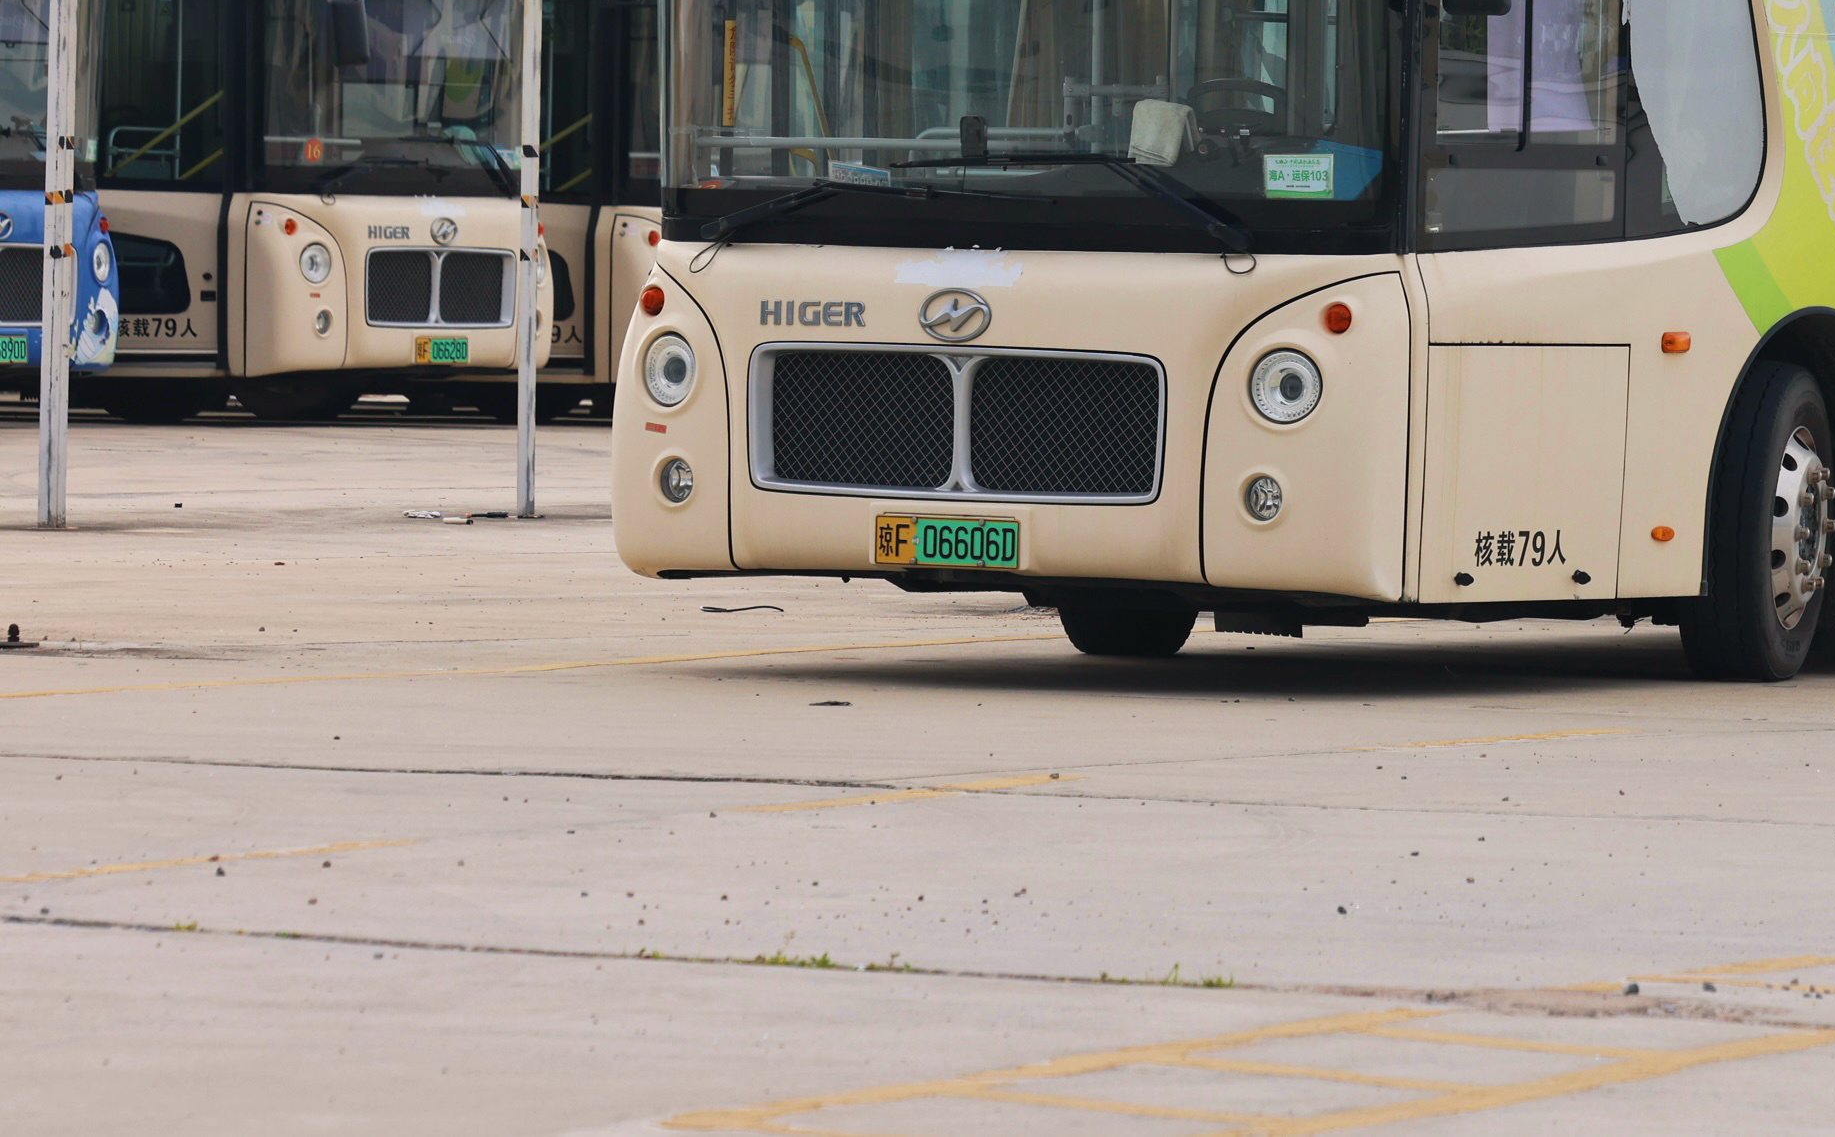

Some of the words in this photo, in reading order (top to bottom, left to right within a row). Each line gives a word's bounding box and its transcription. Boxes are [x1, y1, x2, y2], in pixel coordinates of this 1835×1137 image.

[306, 144, 321, 159] 16
[367, 225, 410, 240] HIGER
[759, 299, 866, 327] HIGER
[0, 341, 26, 359] 890D
[878, 523, 910, 558] 琼F
[922, 524, 1016, 562] 06606D
[1474, 529, 1567, 567] 核载79人
